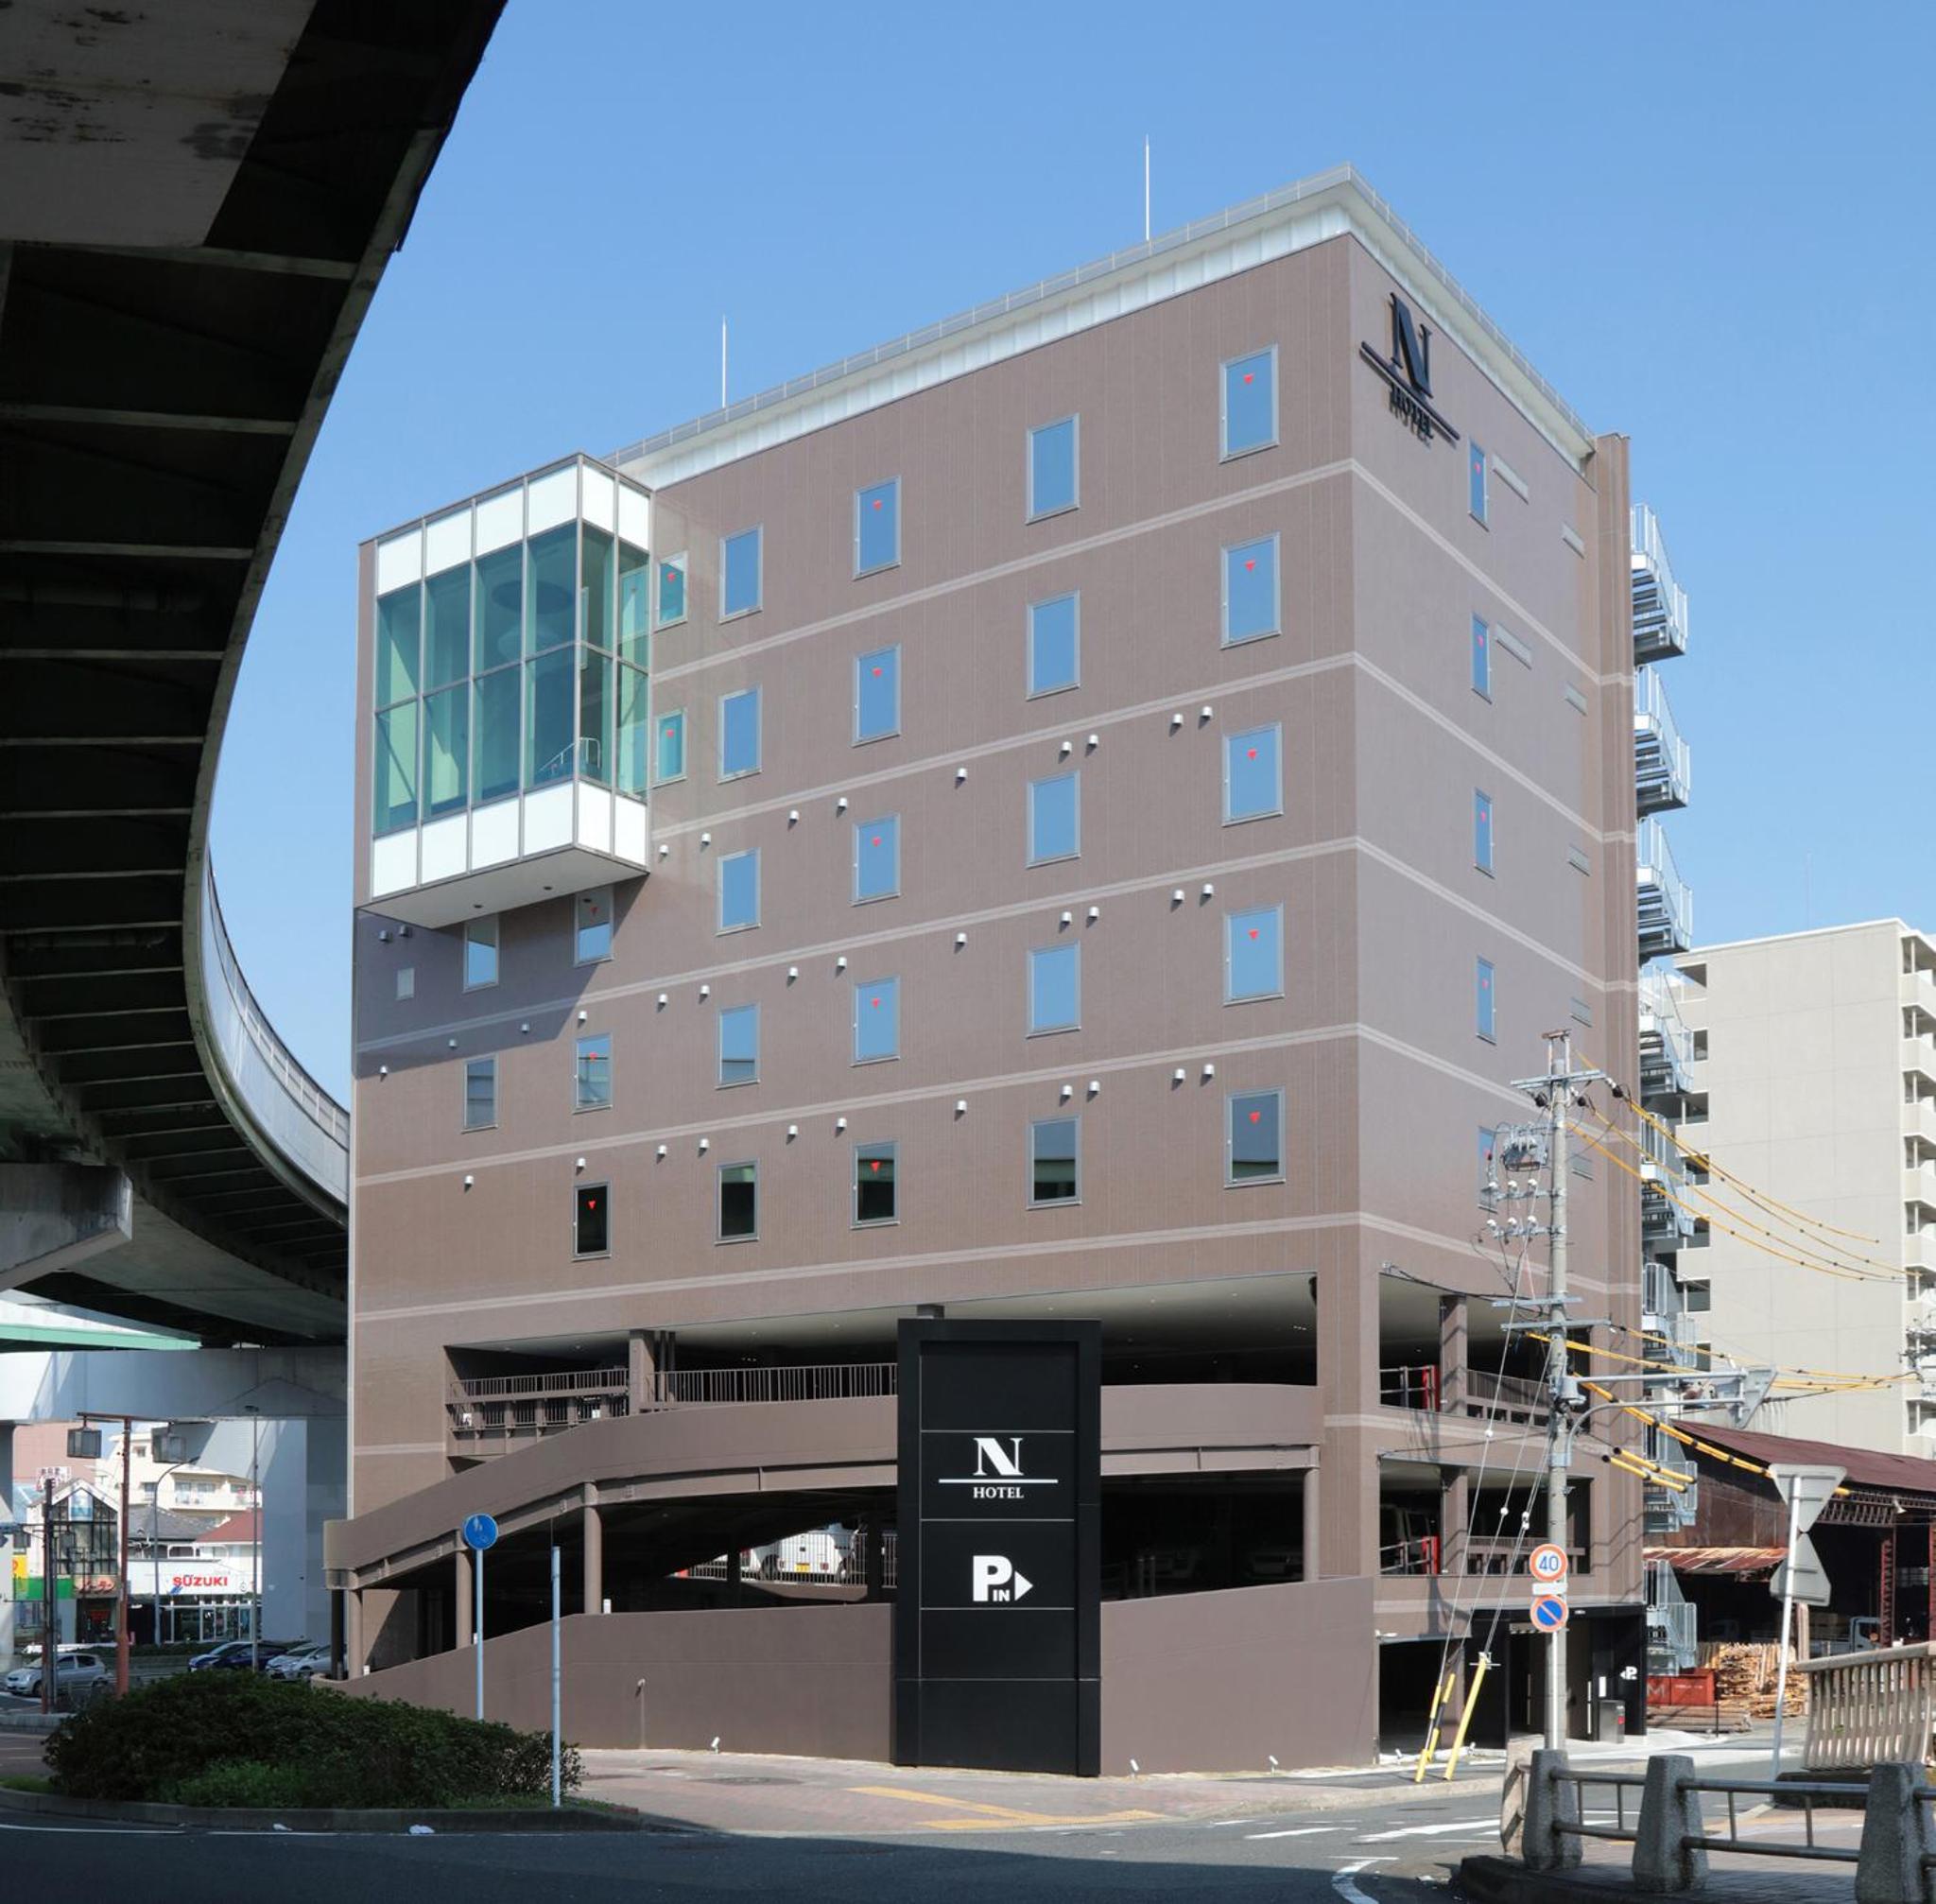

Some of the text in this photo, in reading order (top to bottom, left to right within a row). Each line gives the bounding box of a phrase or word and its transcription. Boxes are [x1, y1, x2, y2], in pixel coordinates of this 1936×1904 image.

[1390, 291, 1434, 399] N
[973, 1437, 1024, 1477] N
[974, 1486, 1025, 1498] HOTEL
[1538, 1555, 1559, 1571] 40
[173, 1576, 228, 1586] SUZUKI
[973, 1555, 1012, 1601] P
[993, 1589, 1011, 1601] IN
